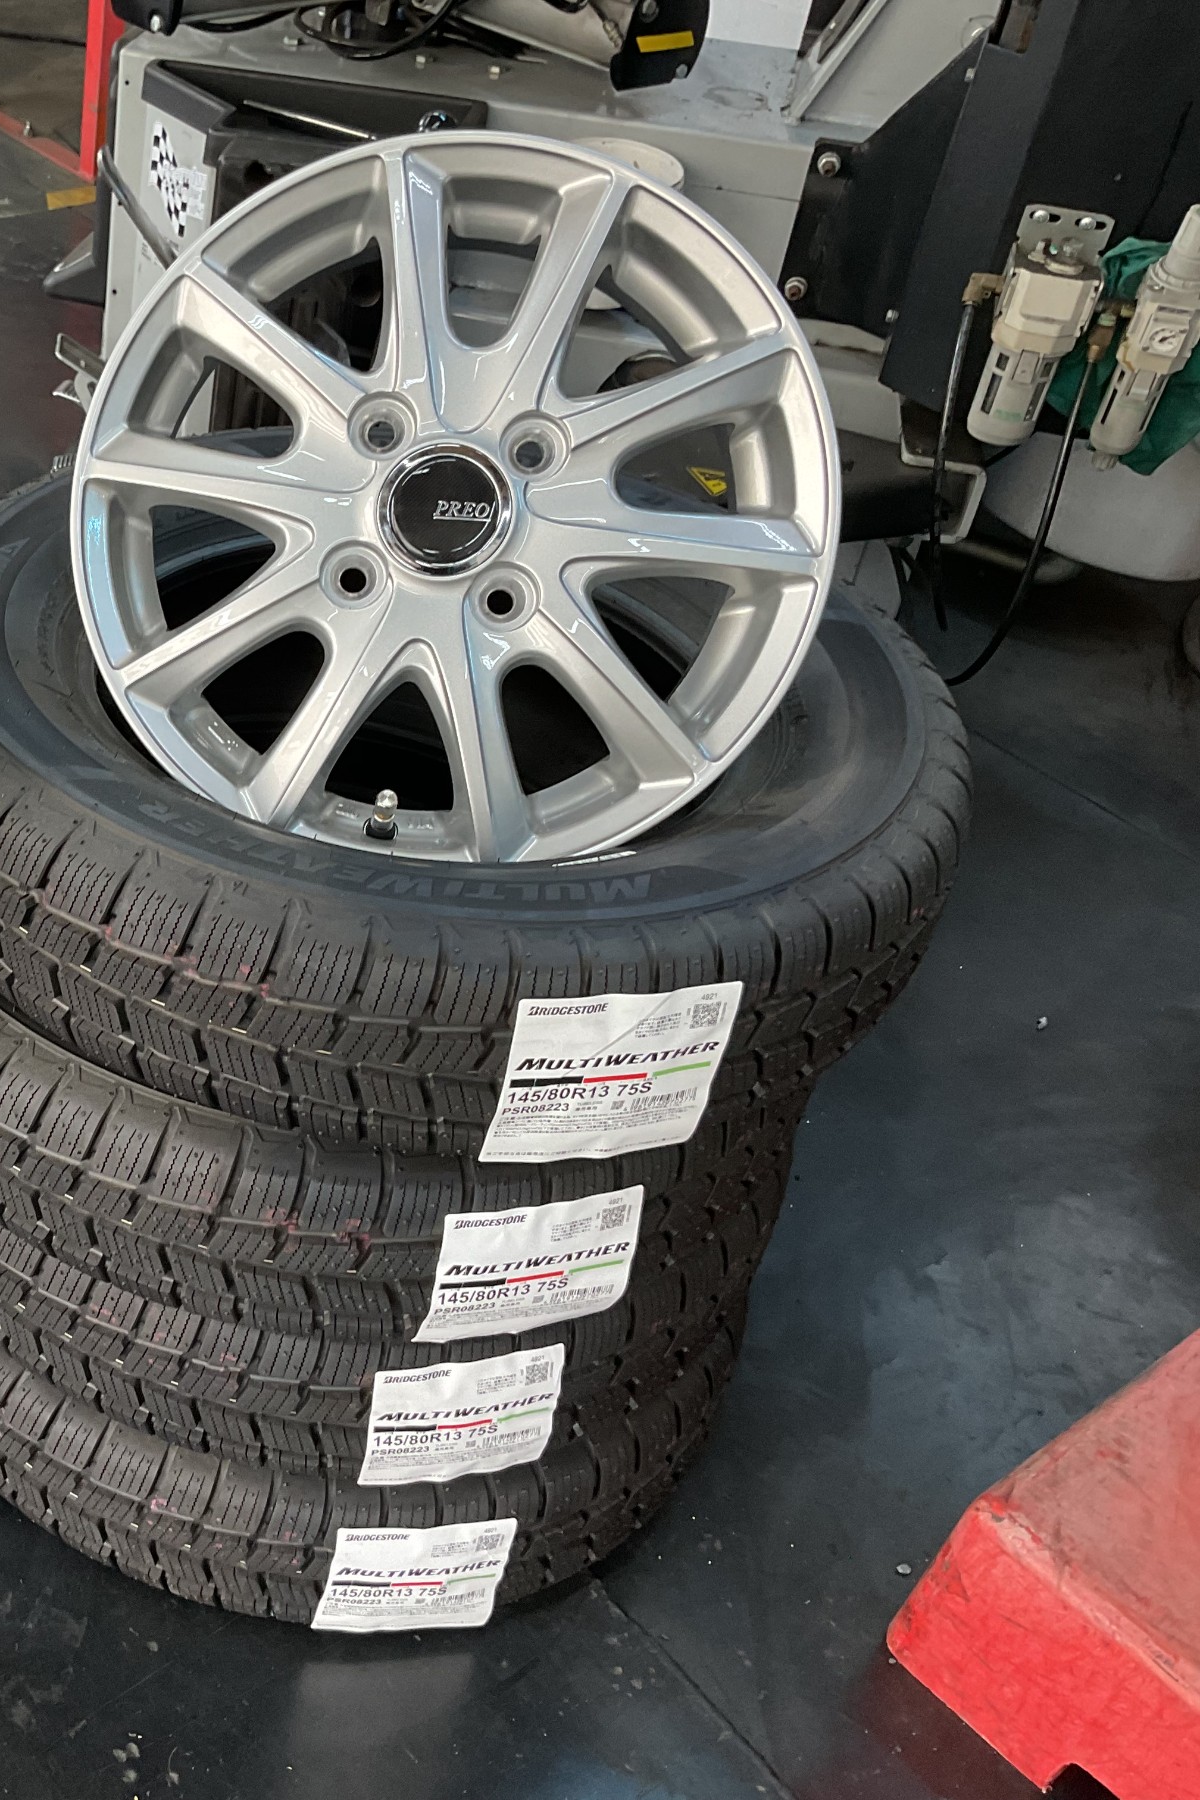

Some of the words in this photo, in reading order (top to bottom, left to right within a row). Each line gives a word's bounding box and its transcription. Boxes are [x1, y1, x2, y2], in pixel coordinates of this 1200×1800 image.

[433, 500, 490, 518] PREO
[527, 1003, 608, 1016] BRIDGESTONE
[515, 1041, 720, 1071] MULTIWEATHER
[507, 1085, 609, 1104] 145/80R13
[617, 1081, 652, 1097] 75S
[502, 1103, 570, 1115] PSR08223
[453, 1214, 527, 1230] BRIDGESTONE
[444, 1242, 630, 1276] MULTIWEATHER
[437, 1285, 530, 1305] 145/80R13
[538, 1278, 569, 1292] 75S
[434, 1303, 495, 1315] PSR08223
[383, 1369, 452, 1384] BRIDGESTONE
[376, 1392, 554, 1421] MULTIWEATHER
[374, 1431, 462, 1447] 145/80R13
[469, 1425, 498, 1438] 75S
[371, 1446, 430, 1456] PSR08223
[344, 1534, 409, 1542] BRIDGESTONE
[336, 1560, 501, 1578] MULTIWEATHER
[331, 1588, 413, 1598] 145/80R13
[419, 1587, 447, 1596] 75S
[326, 1597, 382, 1605] PSR08223
